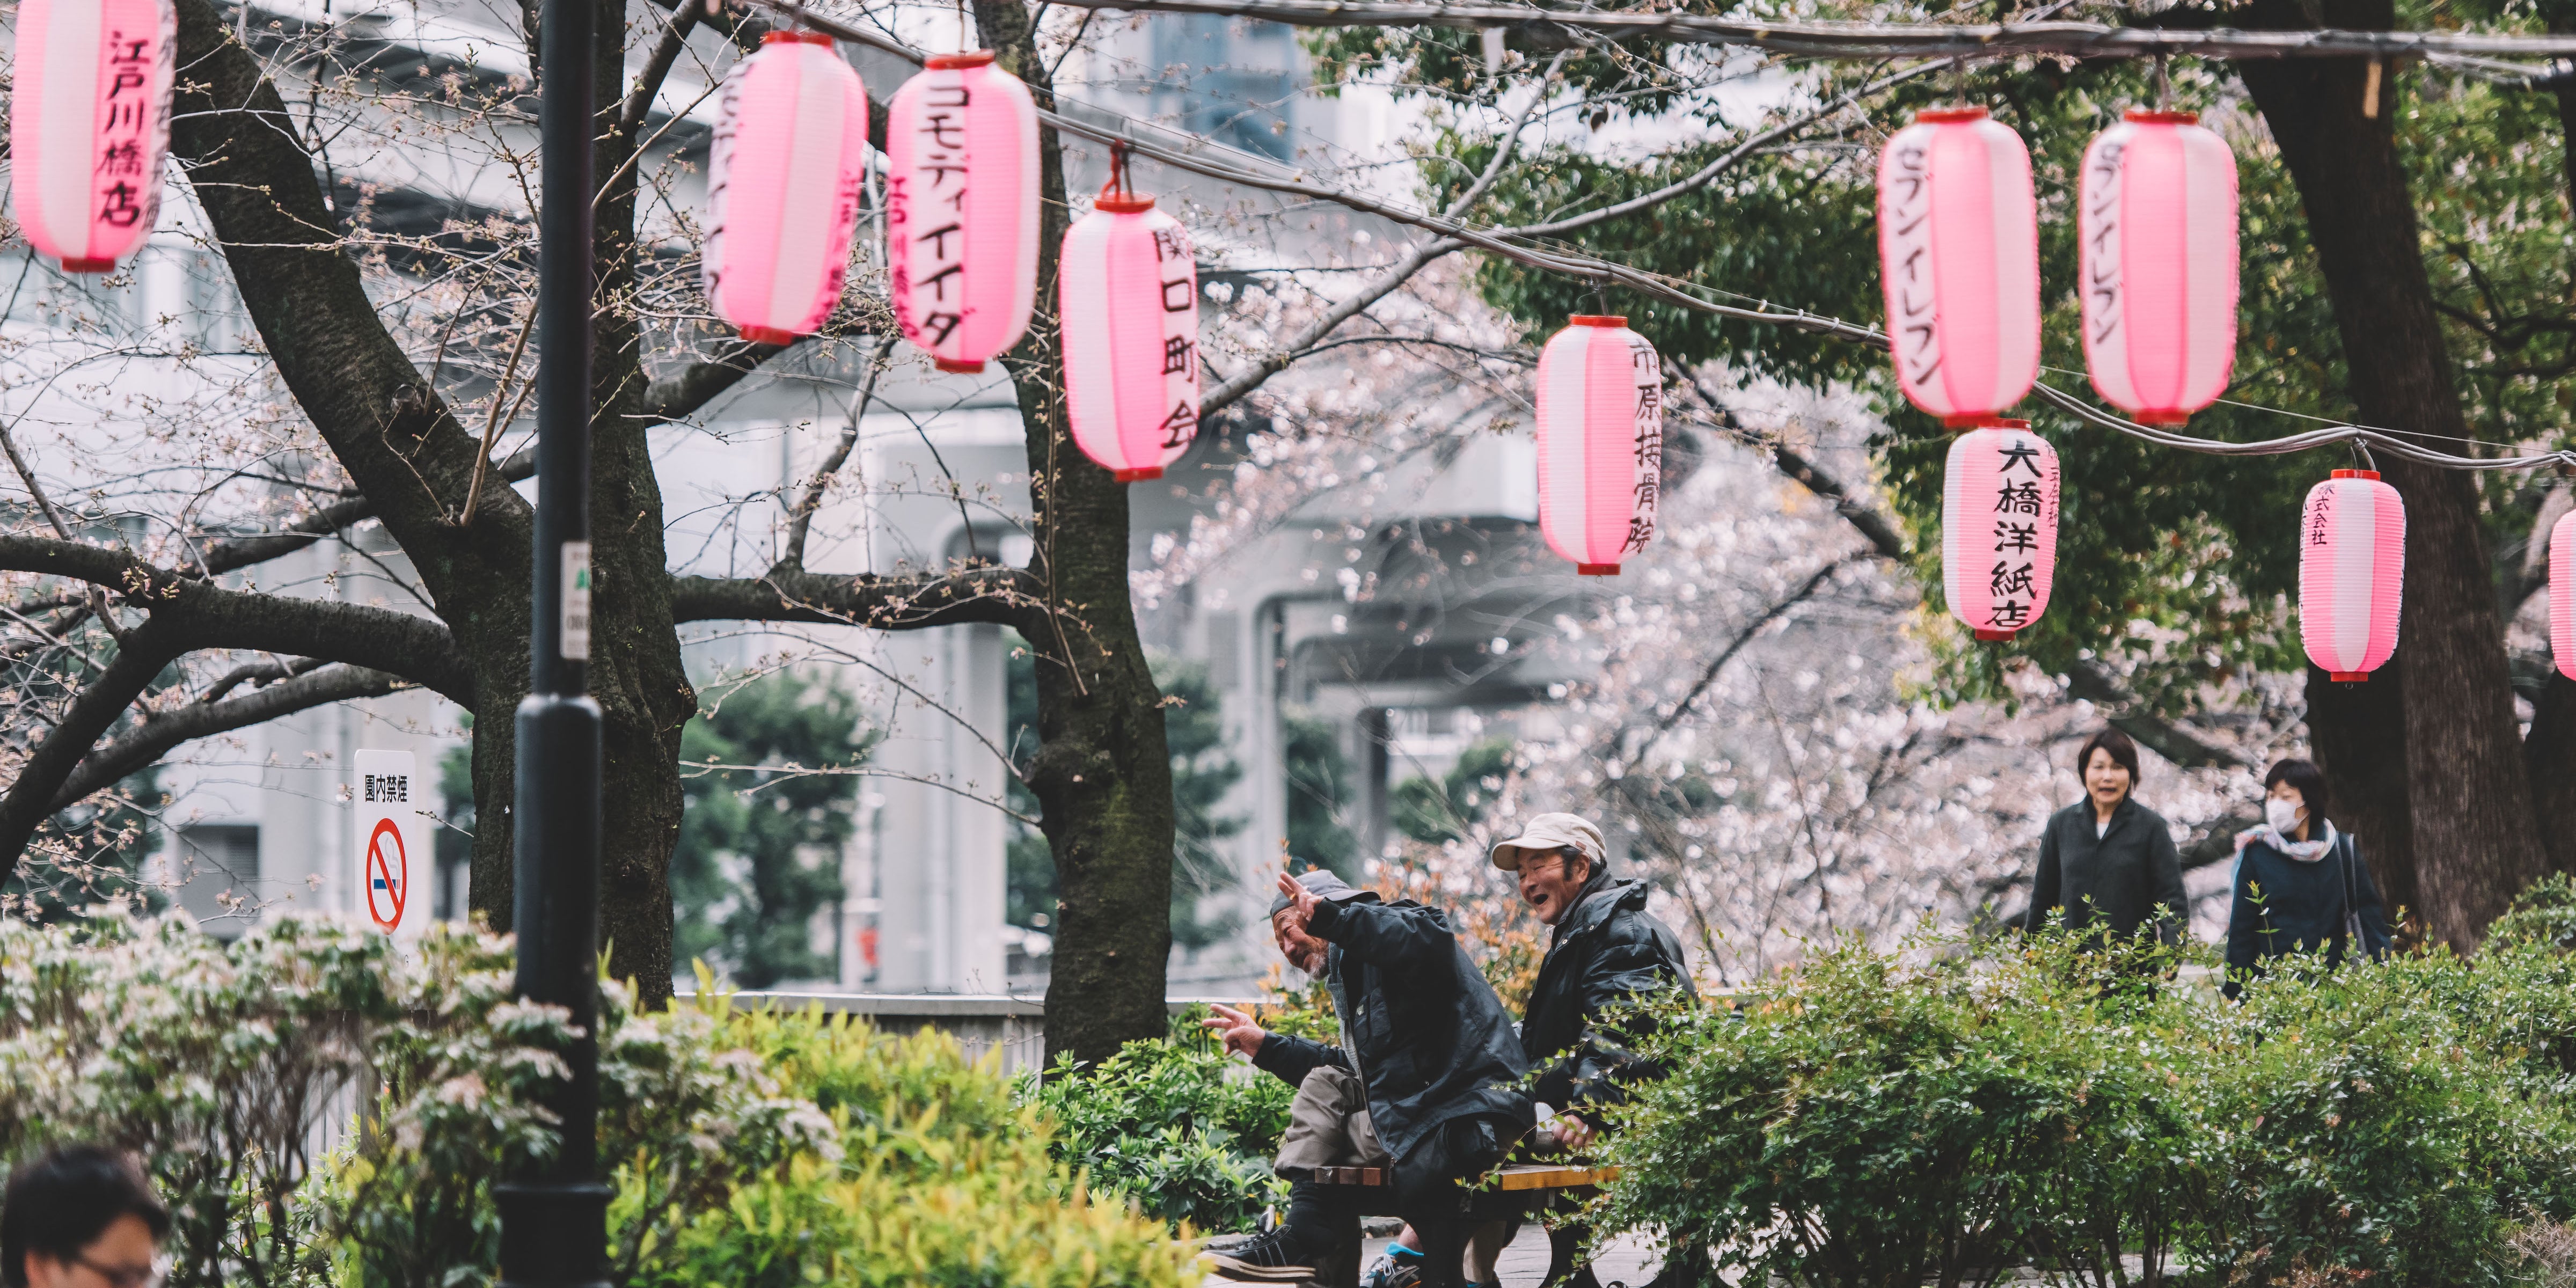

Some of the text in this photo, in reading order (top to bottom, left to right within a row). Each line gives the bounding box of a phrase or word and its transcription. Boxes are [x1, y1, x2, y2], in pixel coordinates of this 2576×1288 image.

[96, 30, 151, 228] 江戸川橋店
[916, 84, 976, 348] コモディイイダ
[1152, 228, 1198, 449] 関口町会
[1895, 145, 1944, 386] セブンイレブン
[2092, 143, 2126, 345] セブンイレブン
[1620, 339, 1662, 554] 市原接骨院
[1985, 438, 2044, 628] 大橋洋紙店
[2311, 483, 2336, 546] 株式会社
[365, 774, 408, 803] 園内禁煙
